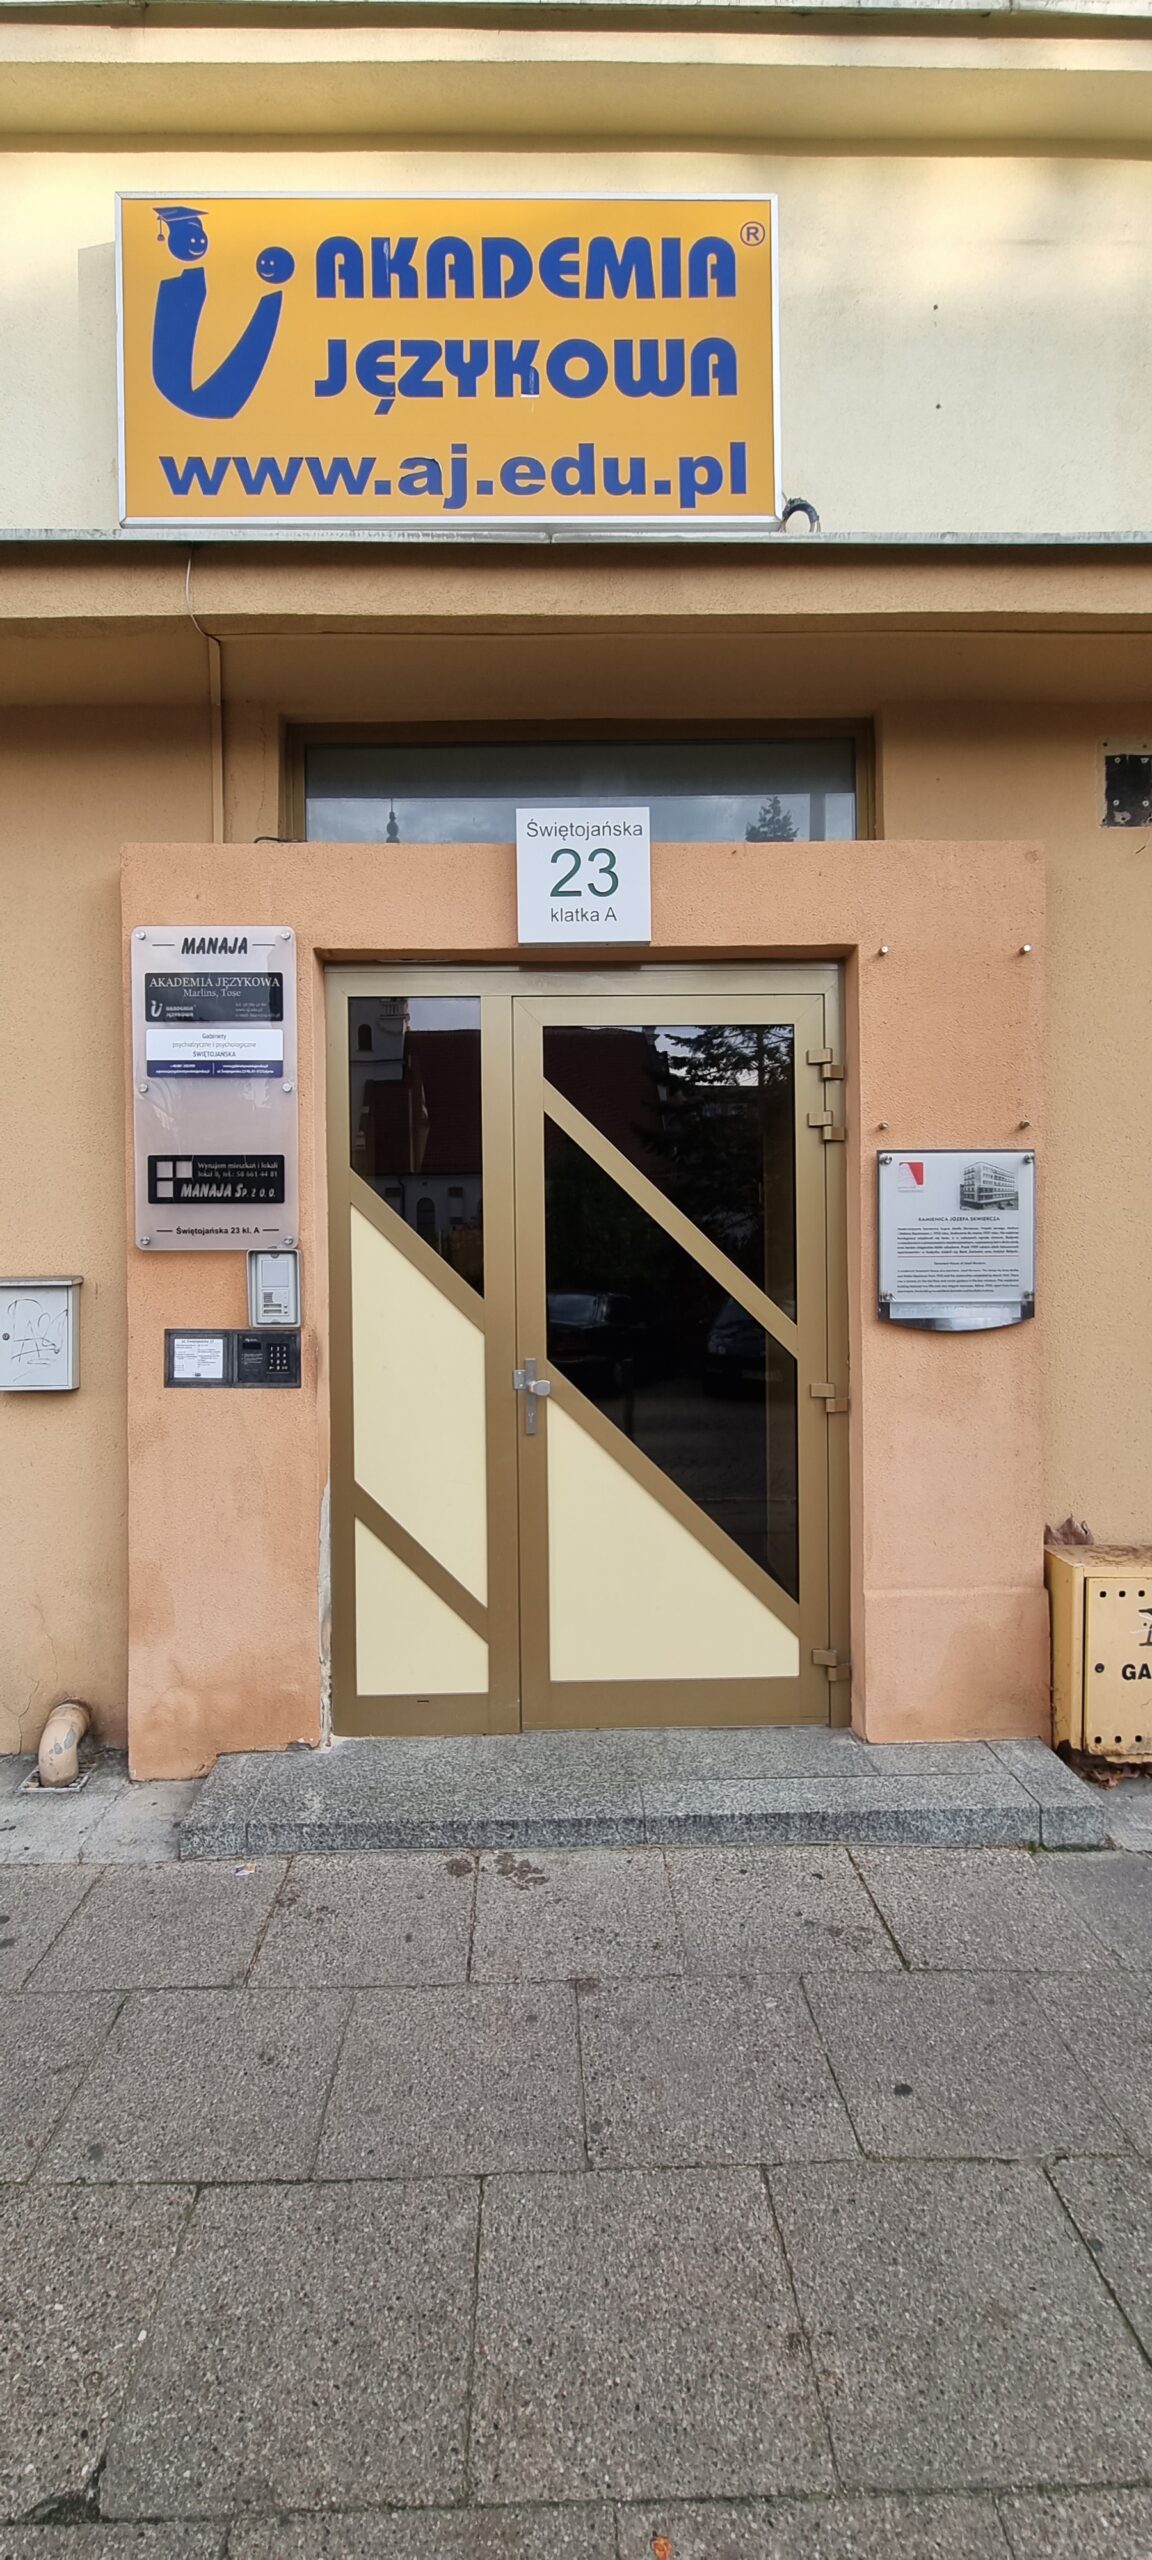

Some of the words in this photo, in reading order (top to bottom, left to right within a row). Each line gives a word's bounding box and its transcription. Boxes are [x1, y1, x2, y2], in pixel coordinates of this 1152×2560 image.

[315, 235, 737, 299] AKADEMIA
[314, 338, 738, 416] JĘZYKOWA
[159, 441, 747, 510] www.aj.edu.pl
[526, 818, 643, 841] Świętojańska
[550, 848, 619, 897] 23
[551, 907, 600, 922] klatka
[604, 906, 617, 921] A
[181, 937, 248, 955] MANAJA
[149, 977, 212, 987] AKADEMIA
[215, 976, 280, 990] JĘZYKOWA
[180, 1184, 232, 1198] MANAJA
[176, 1226, 229, 1236] Świętojańska
[230, 1227, 240, 1235] 23
